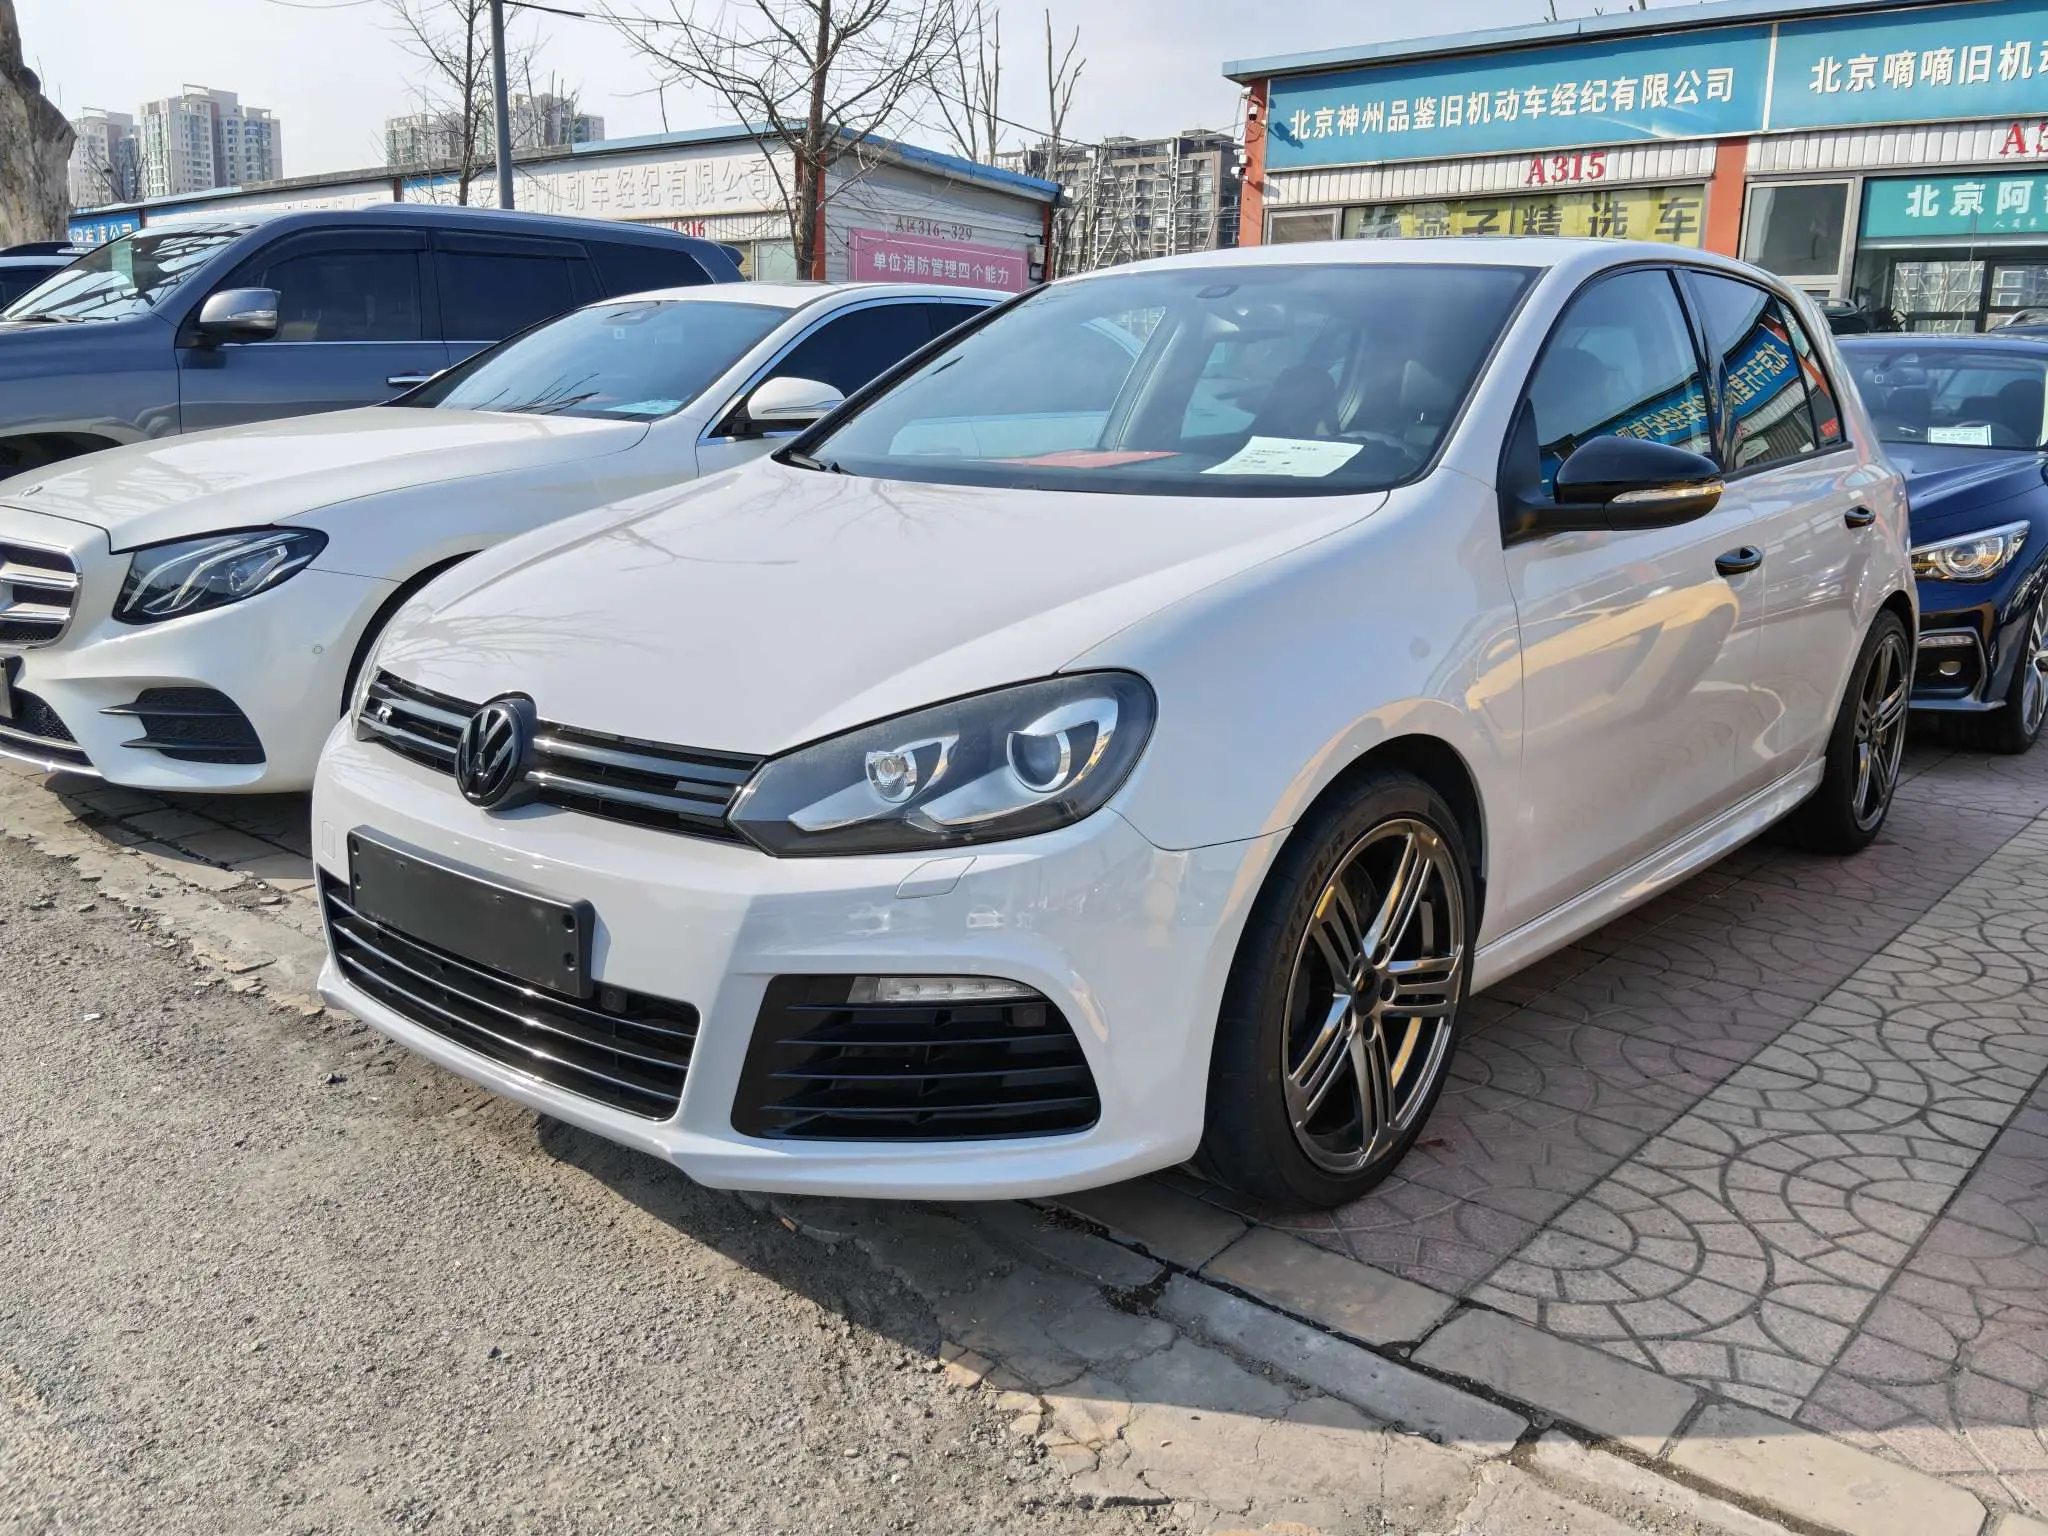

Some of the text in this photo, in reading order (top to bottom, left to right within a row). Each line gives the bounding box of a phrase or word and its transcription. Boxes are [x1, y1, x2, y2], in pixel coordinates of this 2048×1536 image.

[1809, 40, 2048, 94] 北京嘀嘀旧机
[1289, 67, 1735, 141] 北京神州品鉴旧机动车经纪有限公司
[1525, 152, 1607, 186] A315
[1906, 181, 2048, 217] 北京阿
[873, 252, 1009, 285] 单位消防管理四个能力
